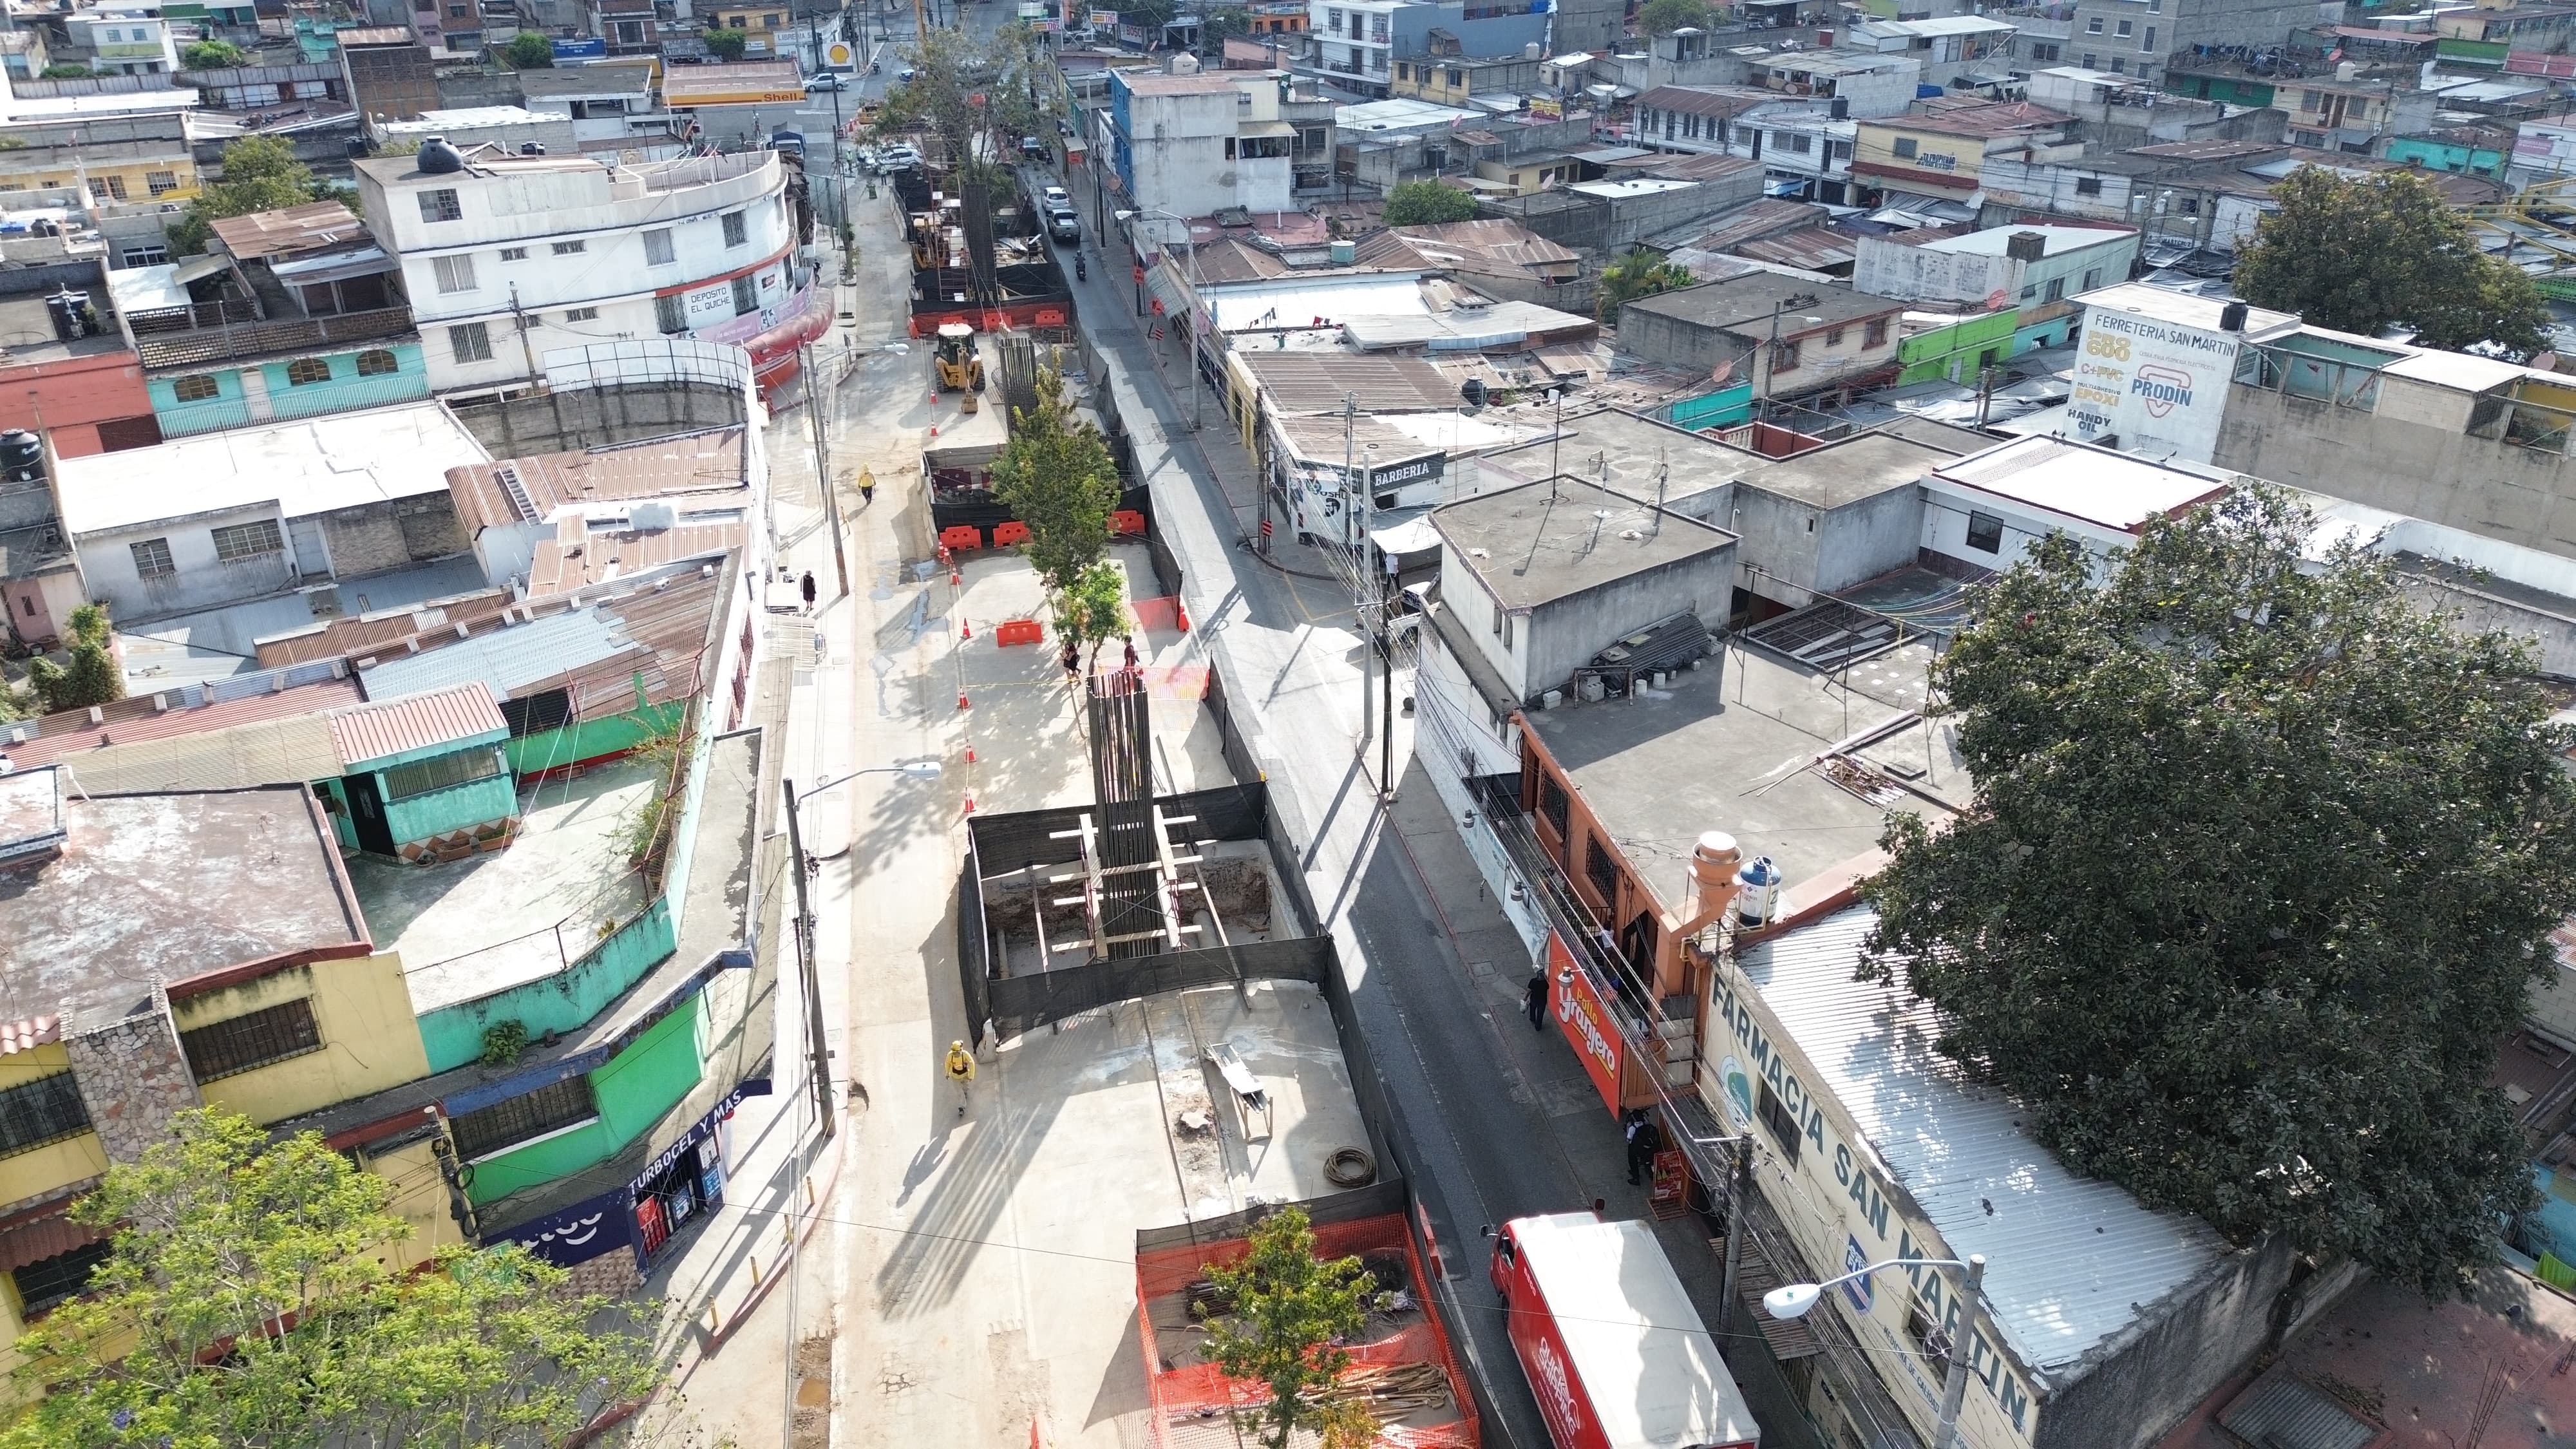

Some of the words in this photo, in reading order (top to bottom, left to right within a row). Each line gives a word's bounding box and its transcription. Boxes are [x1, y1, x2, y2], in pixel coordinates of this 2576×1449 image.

[764, 93, 797, 102] Shell
[691, 287, 727, 303] DEPOSITO
[691, 305, 702, 314] EL
[705, 296, 731, 310] QUICHE
[2088, 330, 2131, 348] PRO
[2095, 314, 2166, 341] FERRETERIA
[2169, 330, 2191, 347] SAN
[2191, 336, 2236, 357] MARTIN
[2087, 340, 2130, 362] 600
[2075, 388, 2120, 407] EPOXI
[2077, 381, 2121, 395] MULTIADHESIVO
[2131, 378, 2193, 407] PRODIN
[2067, 408, 2112, 427] HANDY
[2078, 420, 2098, 433] OIL
[1375, 462, 1430, 487] BARBERIA
[1577, 987, 1598, 1026] Pollo
[1558, 985, 1615, 1071] granjero
[629, 1132, 696, 1196] TURBOCEL
[699, 1116, 708, 1133] Y
[714, 1089, 741, 1123] MAS
[1712, 972, 1823, 1155] FARMACIA
[1835, 1143, 1889, 1241] SAN
[1898, 1227, 2027, 1434] MARTIN
[1541, 1336, 1566, 1394] QUICK
[1884, 1325, 1907, 1367] MEDICINA
[1908, 1363, 1917, 1376] DE
[1917, 1376, 1939, 1412] CALIDAD
[1538, 1347, 1577, 1437] SHIPPING
[1953, 1430, 1968, 1448] EJO
